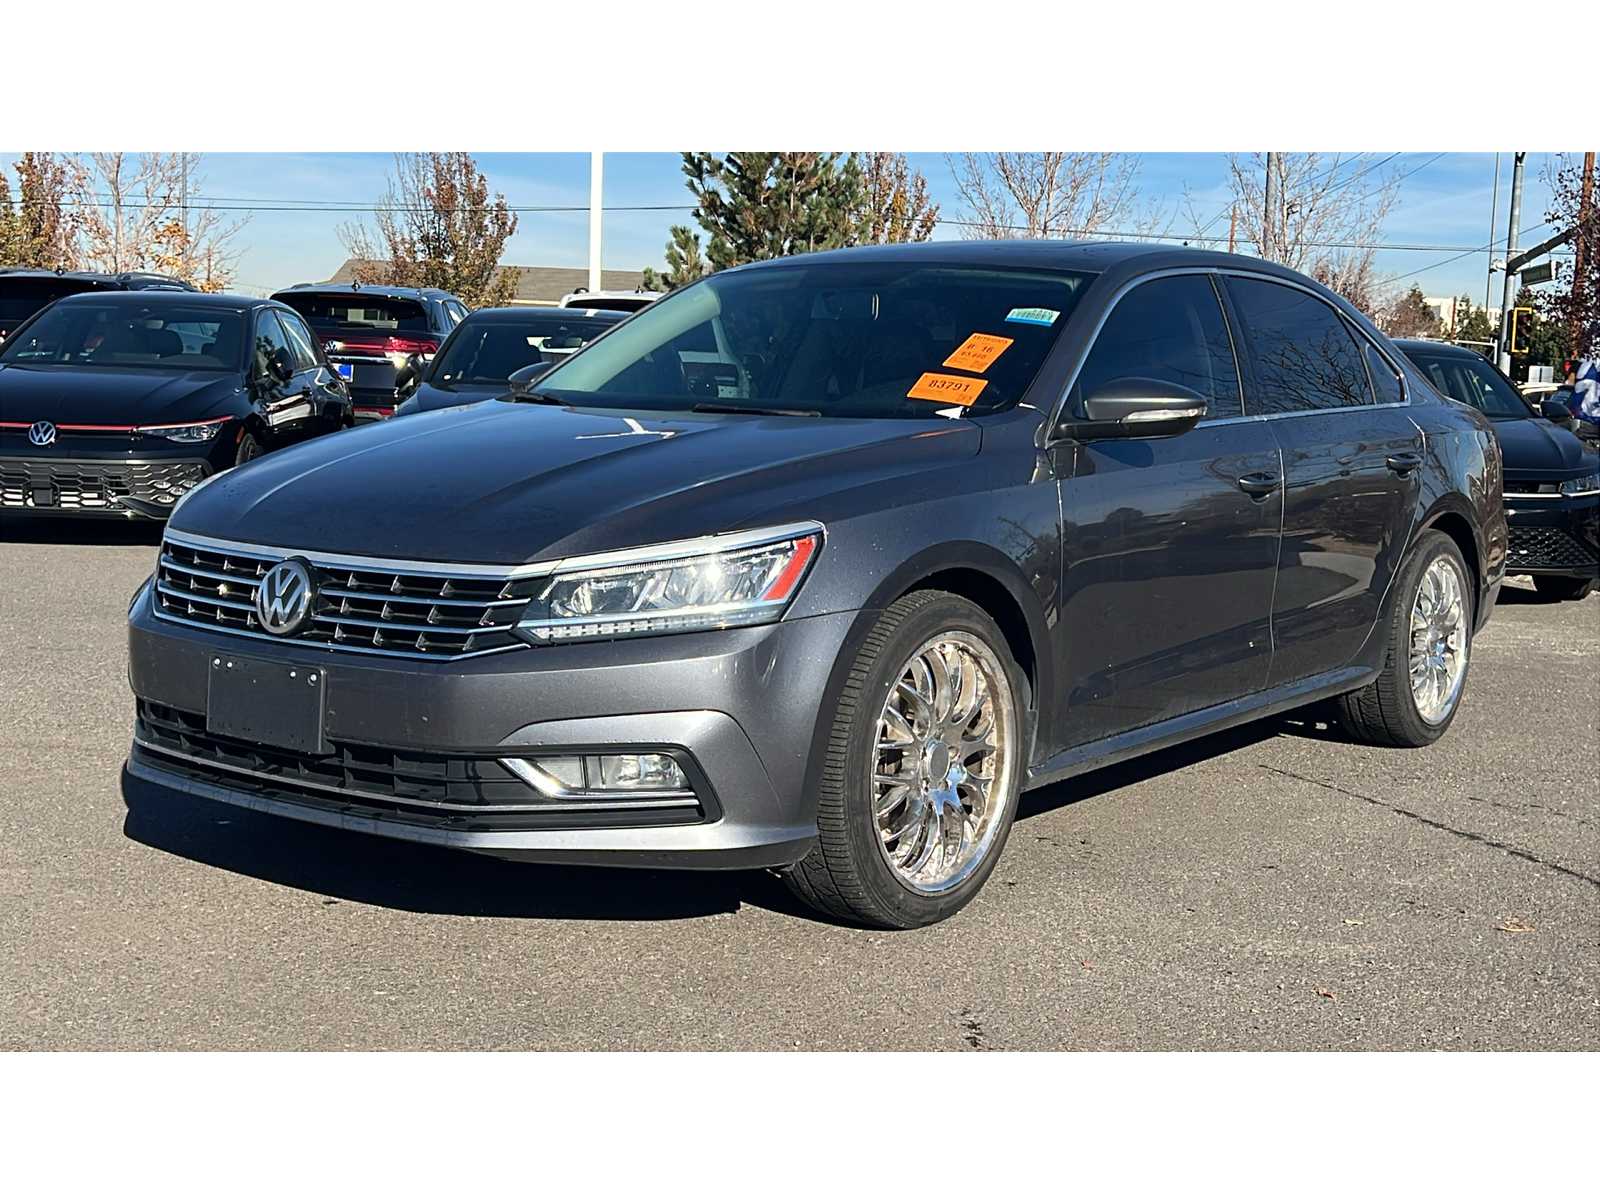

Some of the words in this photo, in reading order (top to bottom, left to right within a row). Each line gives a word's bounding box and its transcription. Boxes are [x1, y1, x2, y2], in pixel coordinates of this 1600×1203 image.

[929, 380, 970, 392] 83791
[30, 421, 55, 445] VW
[257, 561, 310, 633] VW
